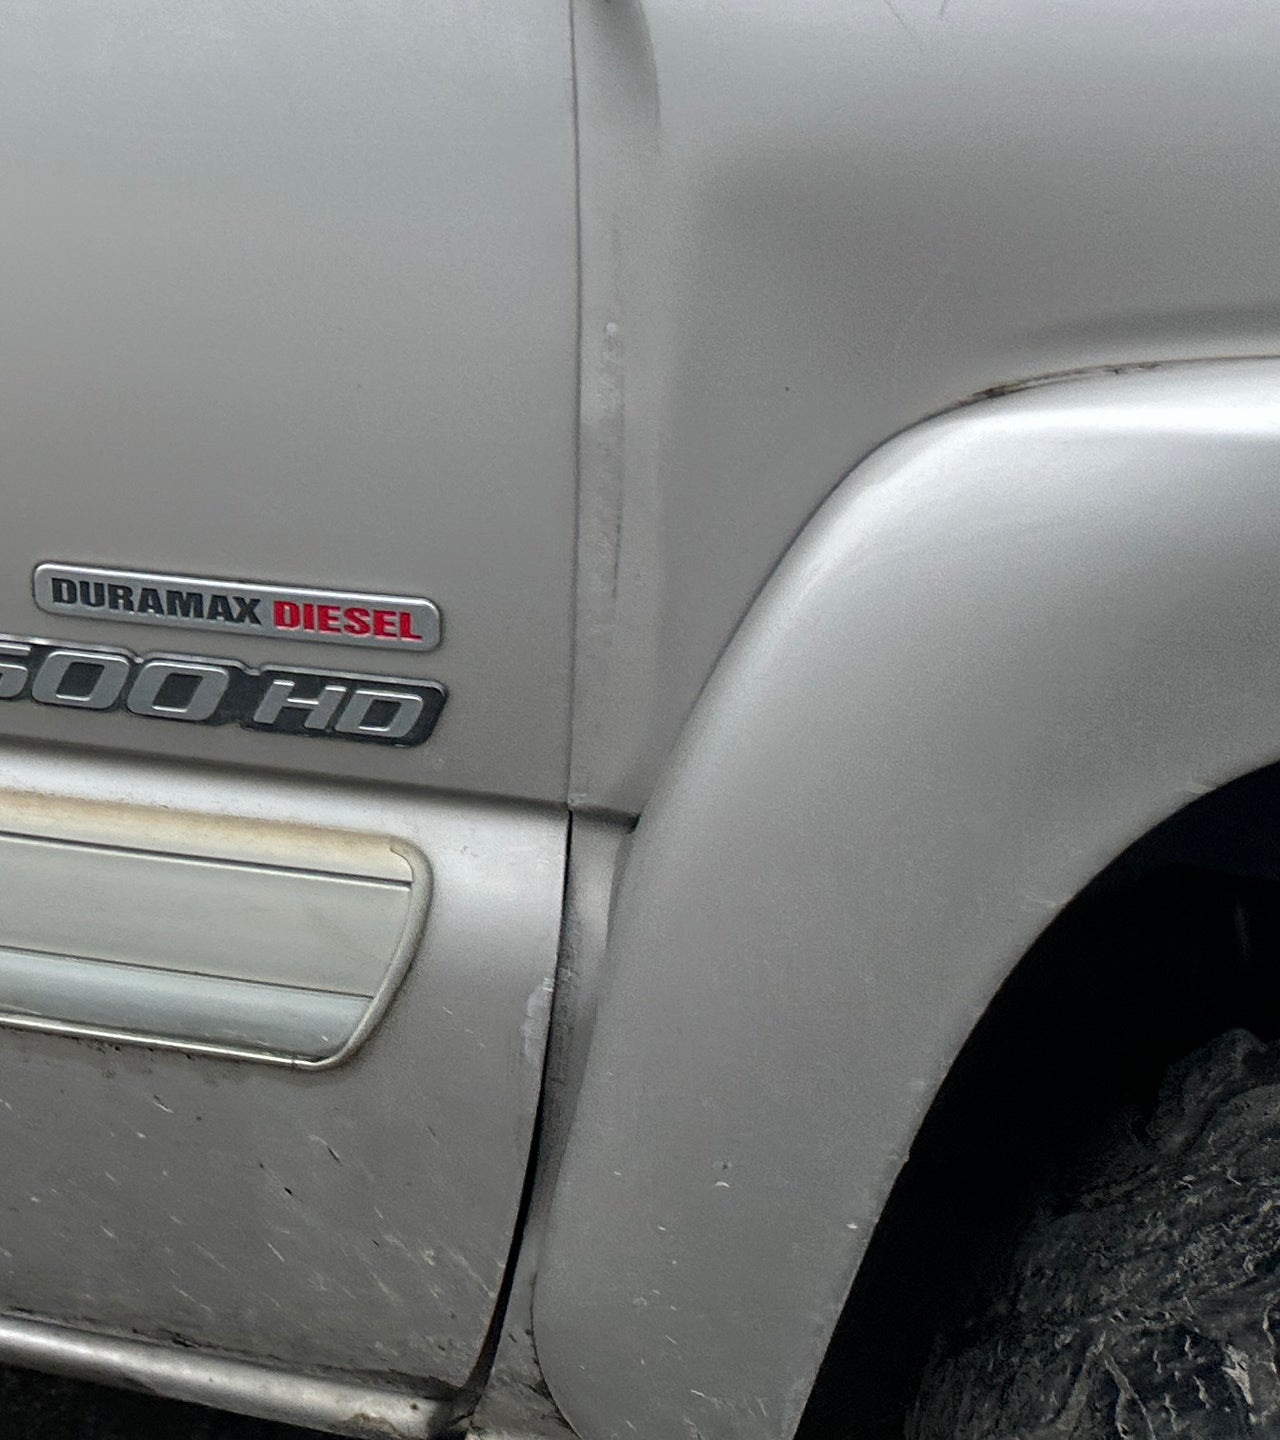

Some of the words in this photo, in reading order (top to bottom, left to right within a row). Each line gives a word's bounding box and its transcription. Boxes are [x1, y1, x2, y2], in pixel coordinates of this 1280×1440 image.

[50, 576, 263, 626] DURAMAX
[272, 599, 424, 643] DIESEL
[251, 678, 425, 739] HD
